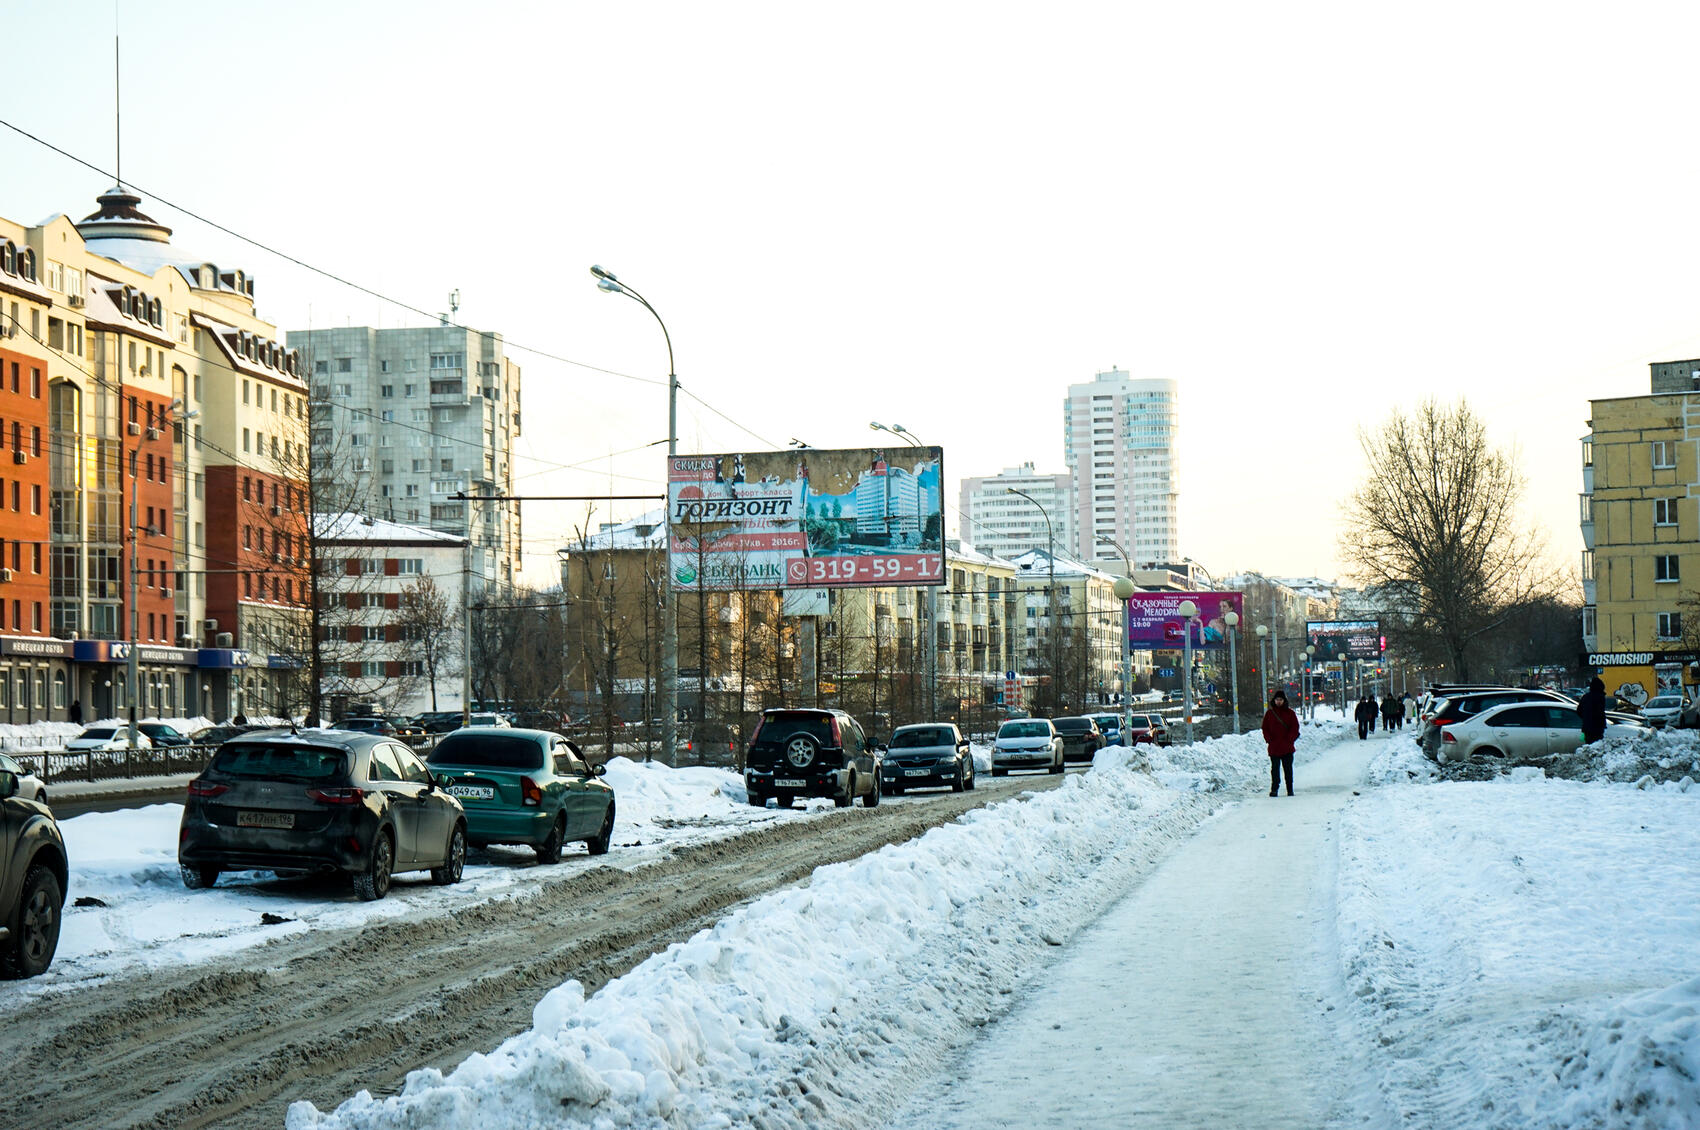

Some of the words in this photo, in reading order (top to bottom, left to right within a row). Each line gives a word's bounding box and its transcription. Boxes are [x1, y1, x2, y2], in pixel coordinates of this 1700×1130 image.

[674, 459, 715, 473] СКИДКА
[675, 500, 793, 518] ГОРИЗОНТ
[771, 538, 800, 547] 2016г.
[813, 557, 943, 580] 319-59-17
[12, 641, 45, 653] НЕМЕЦКАЯ
[45, 643, 65, 654] ОБУВЬ
[141, 649, 168, 661] НЕМЕЦКАЯ
[168, 651, 185, 661] ОБУВЬ
[1588, 652, 1655, 666] COSMOSHOP
[482, 787, 491, 795] 96
